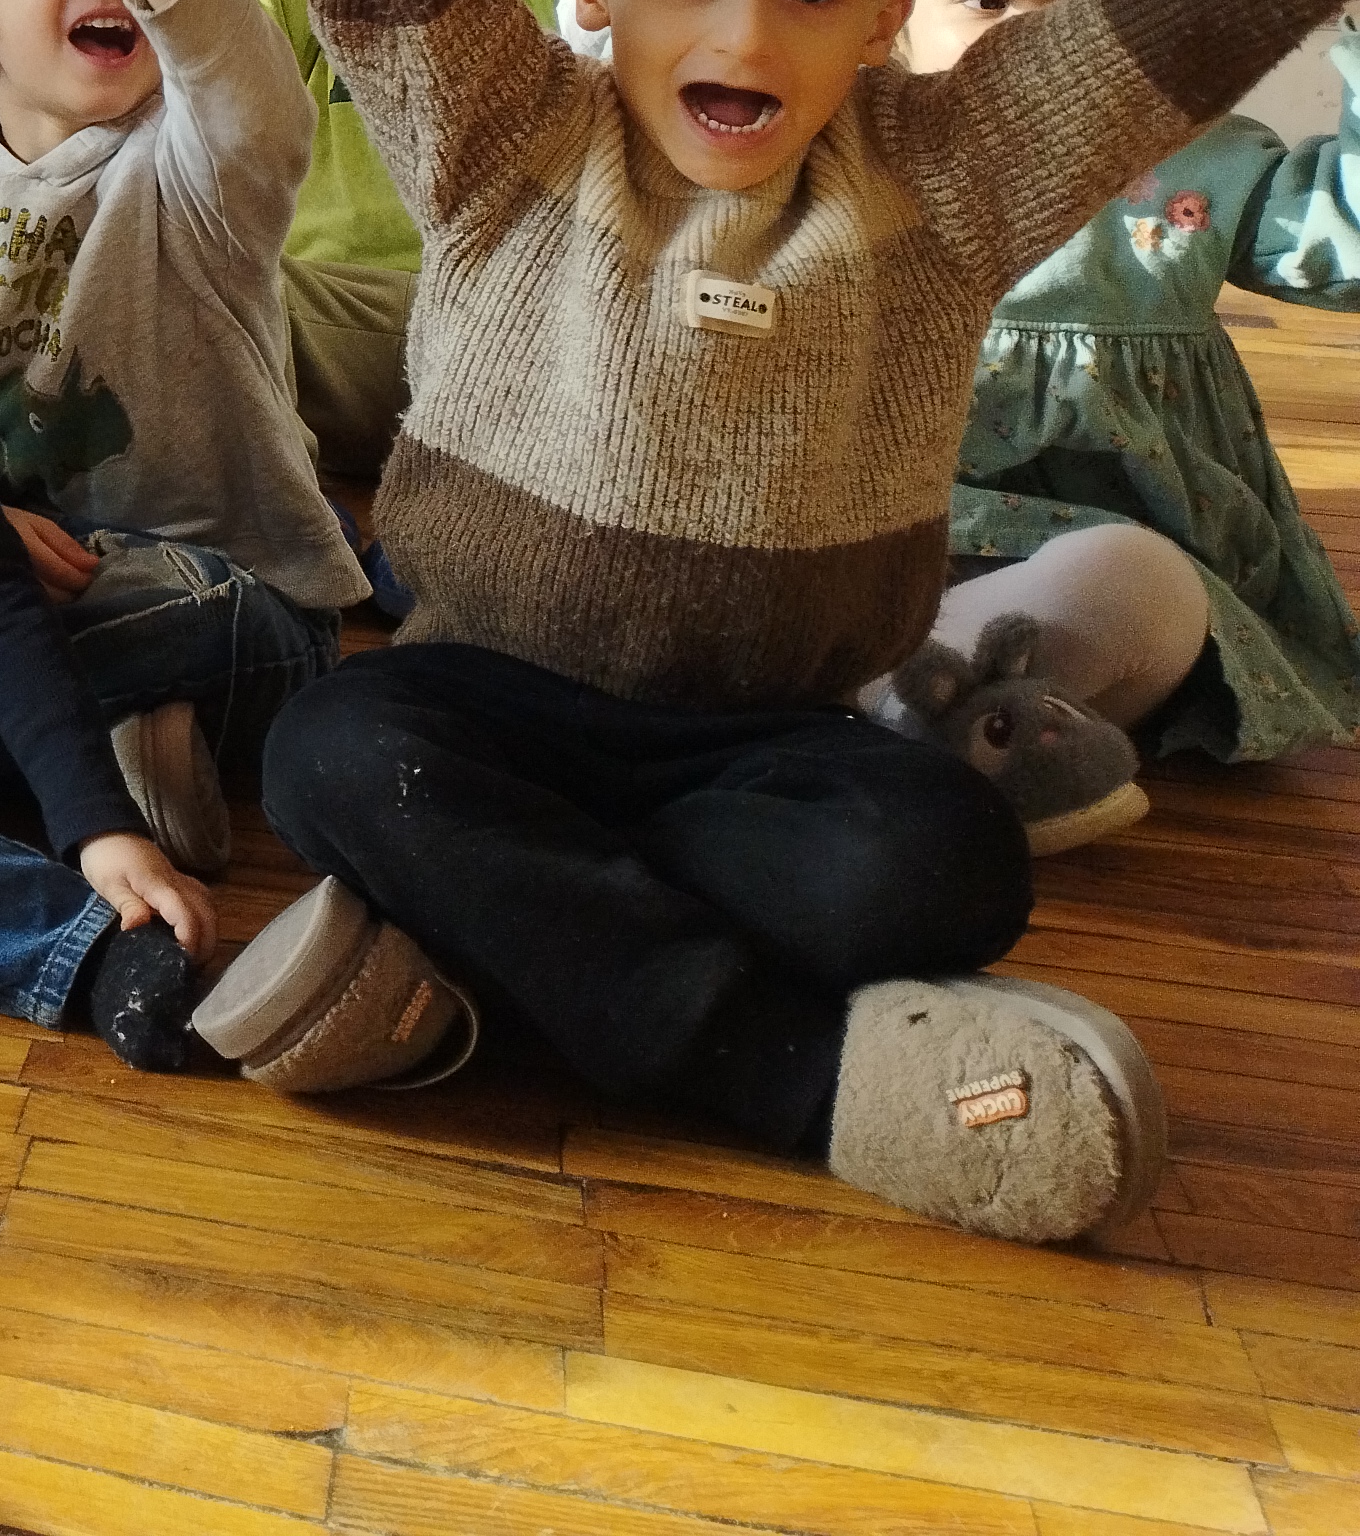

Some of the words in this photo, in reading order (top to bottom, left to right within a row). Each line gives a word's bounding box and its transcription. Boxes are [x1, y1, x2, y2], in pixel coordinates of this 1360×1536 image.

[712, 293, 758, 313] STEAL
[945, 1070, 1022, 1102] SUPERME
[962, 1092, 1021, 1122] LUCKY
